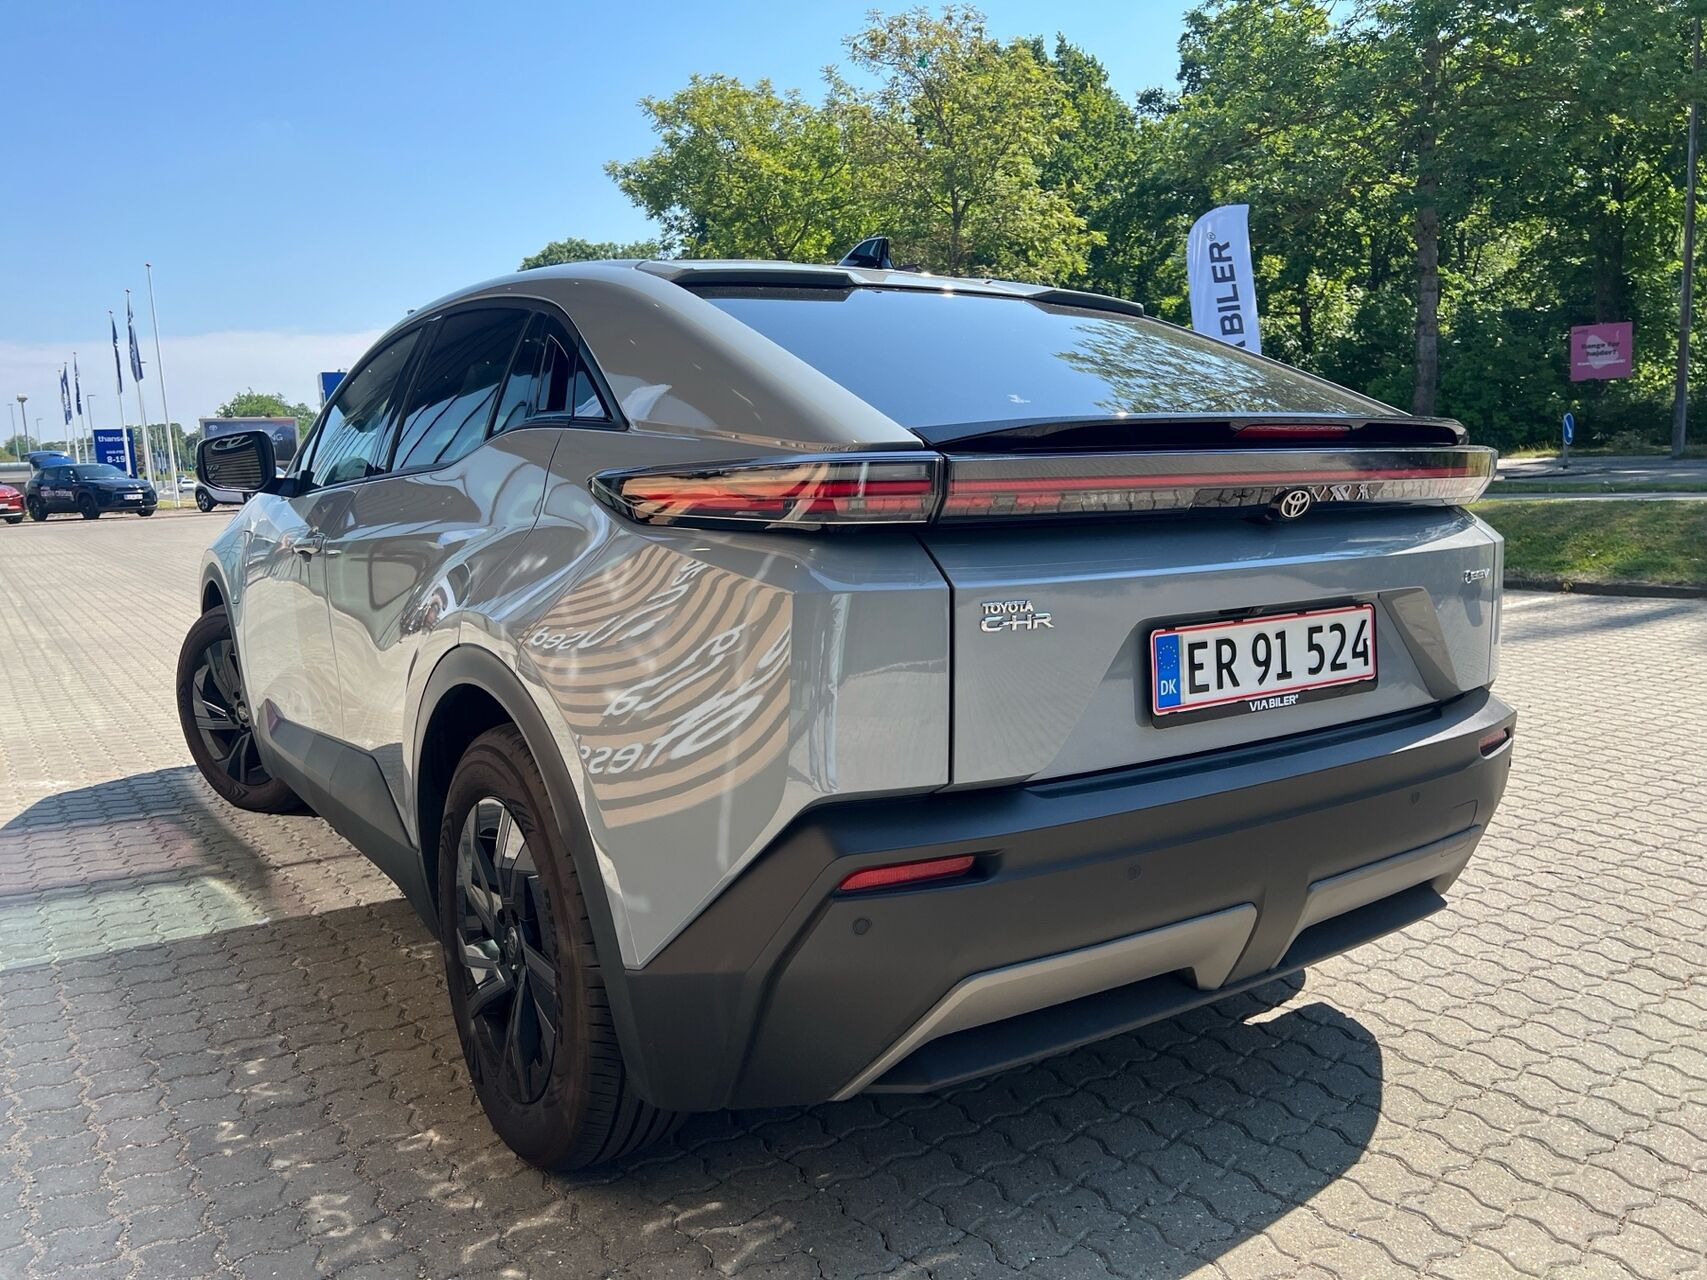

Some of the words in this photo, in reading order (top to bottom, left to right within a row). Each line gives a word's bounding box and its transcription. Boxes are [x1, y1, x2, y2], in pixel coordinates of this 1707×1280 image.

[982, 600, 1034, 614] TOYOTA
[1187, 637, 1240, 694] ER
[1251, 630, 1292, 686] 91
[1307, 619, 1369, 676] 524
[1160, 678, 1177, 696] DK
